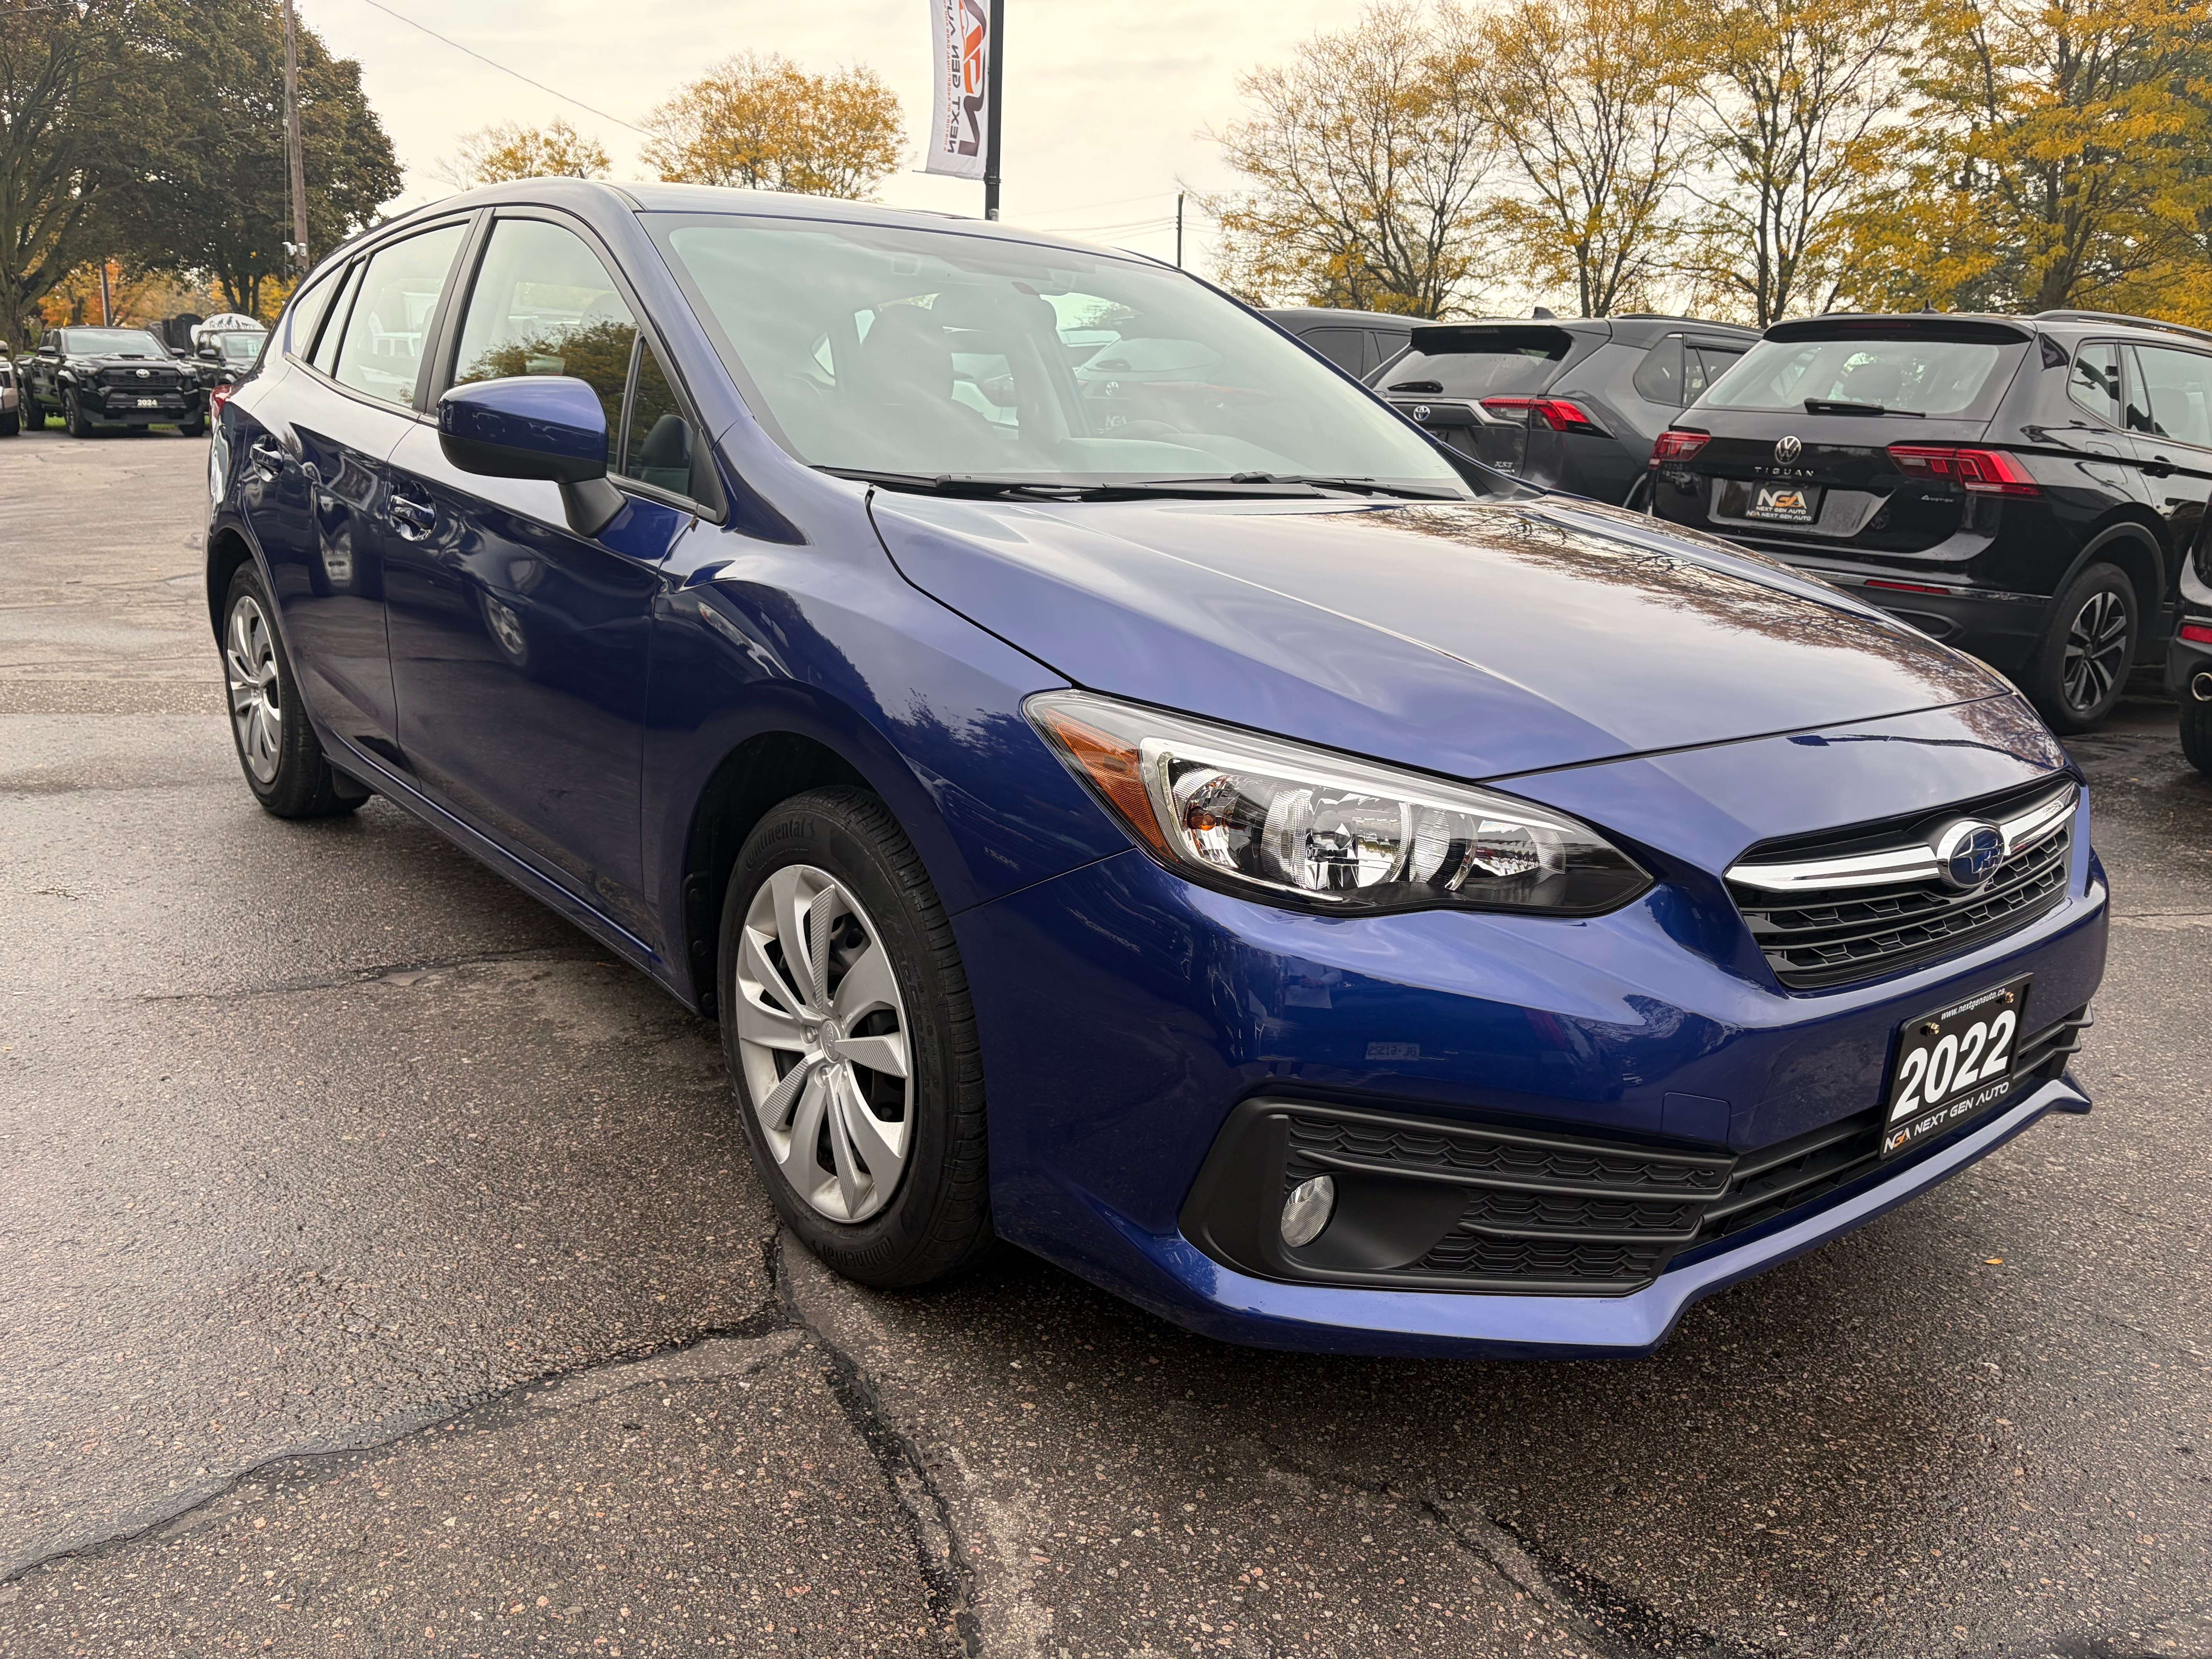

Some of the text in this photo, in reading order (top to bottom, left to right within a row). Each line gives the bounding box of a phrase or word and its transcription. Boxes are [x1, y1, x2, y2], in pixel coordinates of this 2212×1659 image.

[1754, 466, 1814, 476] TIGUAN
[1757, 488, 1807, 509] NGA
[745, 817, 805, 871] Continental
[1941, 988, 2005, 1020] www.nextgenauto.ca
[1890, 1010, 2016, 1122] 2022
[1883, 1082, 2009, 1154] NGA NEXT GEN AUTO
